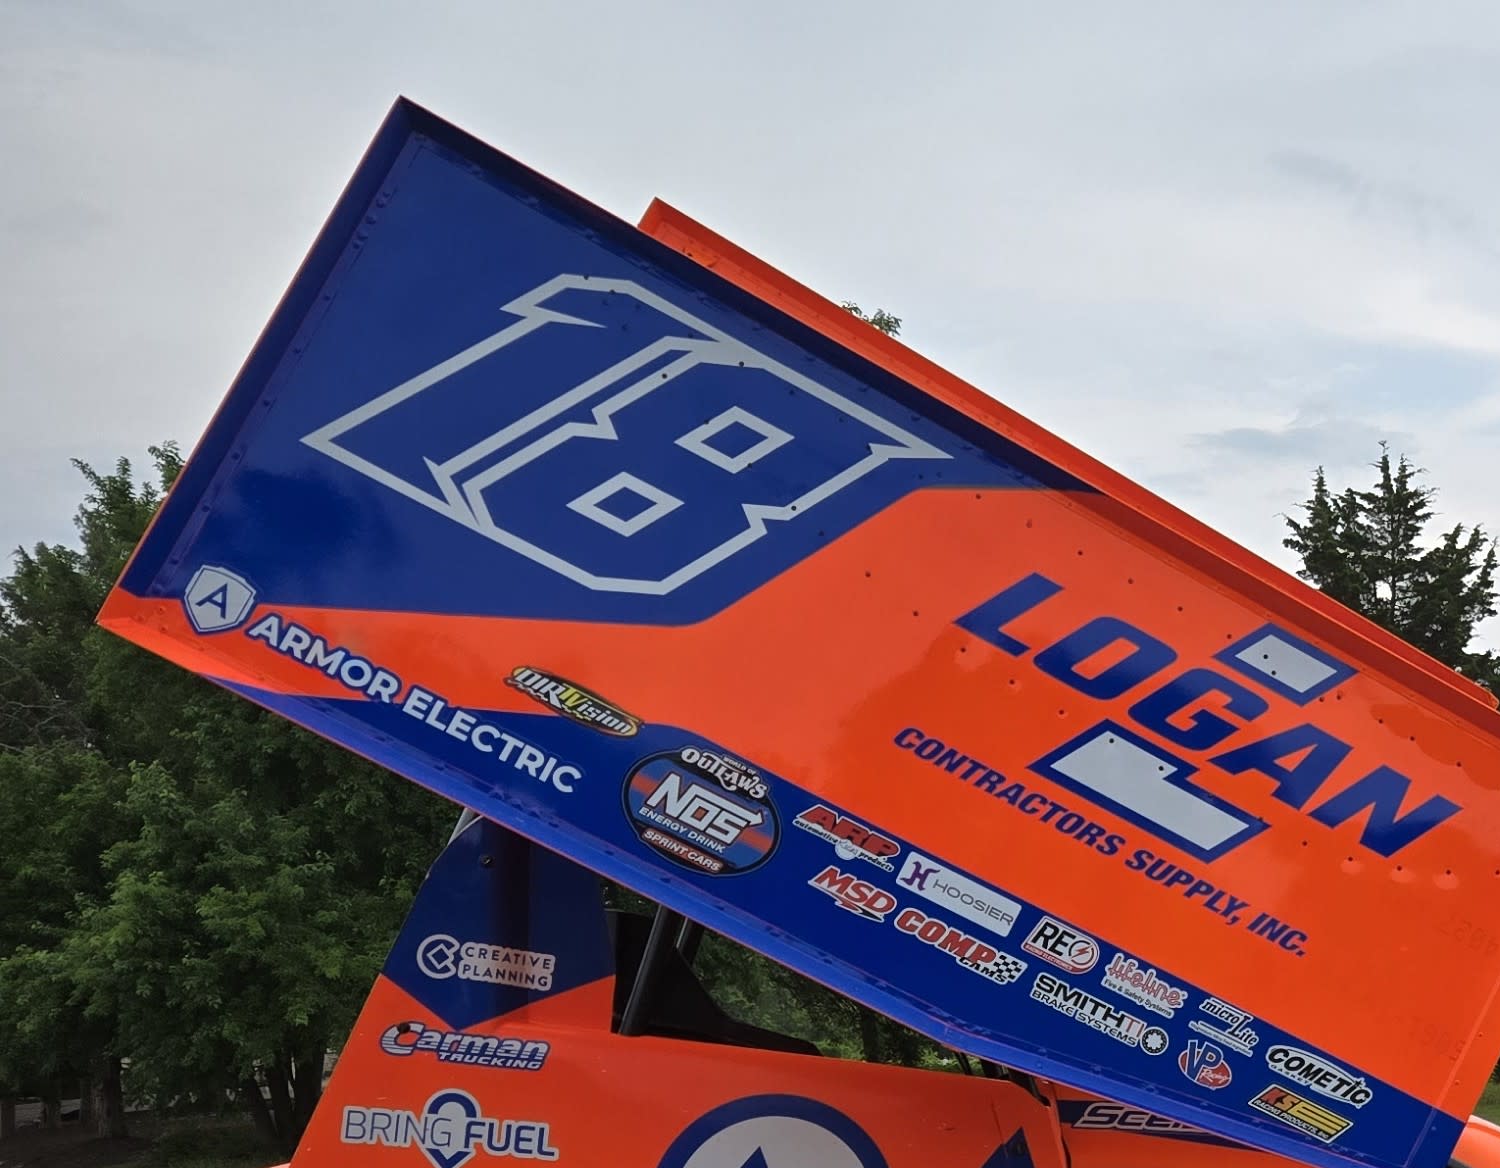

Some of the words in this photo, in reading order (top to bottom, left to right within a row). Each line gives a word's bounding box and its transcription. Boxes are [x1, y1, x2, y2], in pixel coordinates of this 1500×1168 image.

[299, 274, 954, 595] 18
[247, 615, 399, 704] ARMOR
[402, 688, 582, 793] ELECTRIC
[954, 572, 1464, 858] LOGAN
[682, 748, 767, 799] OUTLAWS
[638, 807, 687, 835] ENERGY
[687, 828, 725, 854] DRINK
[646, 773, 764, 844] NOS
[800, 806, 899, 857] ARP
[644, 830, 687, 855] SPRINT
[687, 845, 722, 872] CARS
[893, 727, 1127, 857] CONTRACTORS
[1125, 848, 1244, 928] SUPPLY,
[1246, 911, 1308, 957] INC.
[814, 866, 896, 914] MSD
[933, 880, 1014, 926] HOOSIER
[464, 946, 553, 971] CREATIVE
[896, 909, 997, 964] COMP
[462, 964, 550, 988] PLANNING
[959, 956, 1008, 984] CAMS
[1031, 990, 1074, 1016] BRAKE
[1078, 1012, 1137, 1046] SYSTEMS
[1144, 998, 1172, 1017] Systems
[380, 1022, 550, 1061] Carman
[438, 1051, 543, 1070] TRUCKING
[1185, 1040, 1223, 1082] VP
[1268, 1048, 1371, 1104] COMETIC
[1254, 1099, 1282, 1115] RACING
[344, 1109, 453, 1147] BRING
[464, 1121, 556, 1157] FUEL
